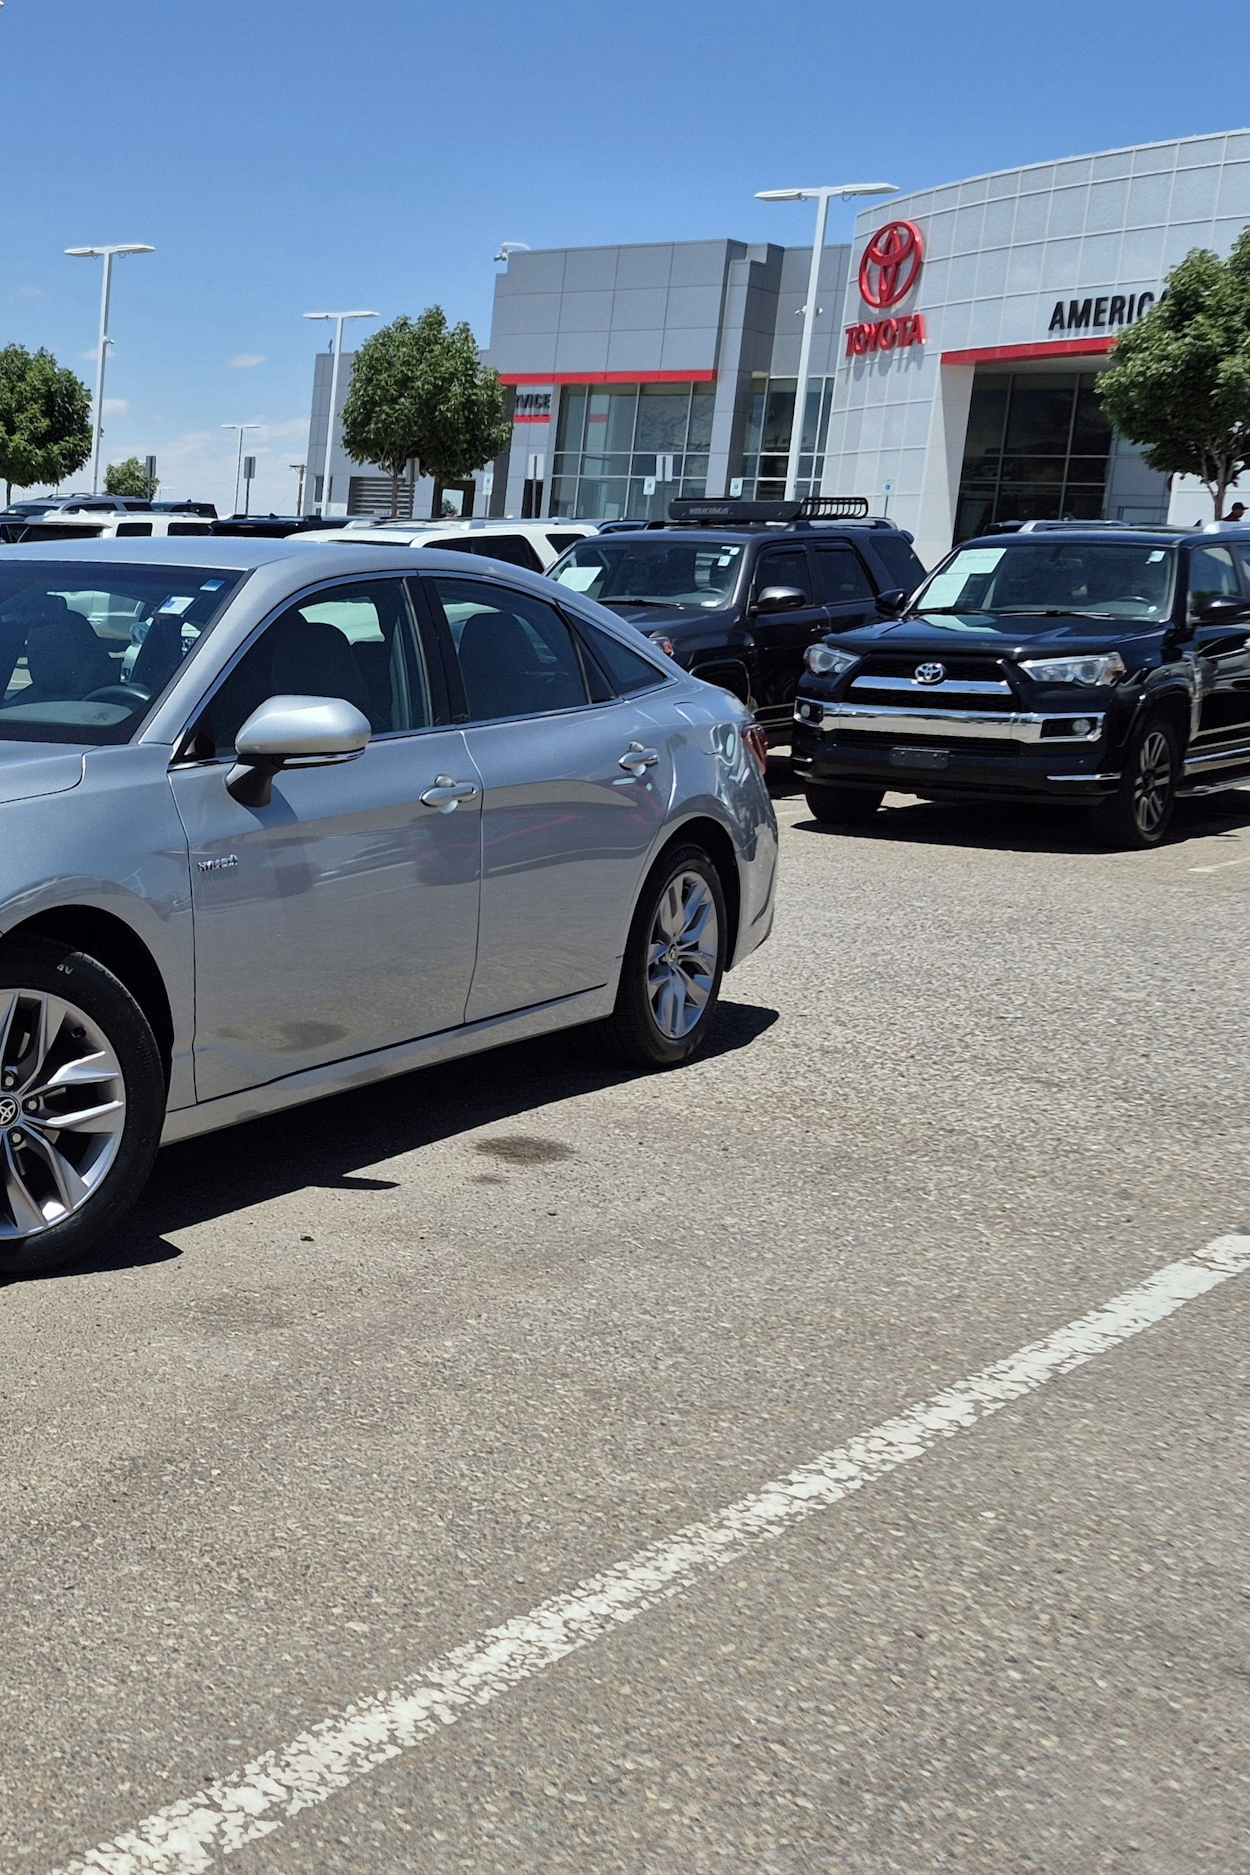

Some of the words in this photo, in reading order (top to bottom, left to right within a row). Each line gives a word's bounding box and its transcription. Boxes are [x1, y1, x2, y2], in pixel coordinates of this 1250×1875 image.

[1048, 288, 1169, 331] AMERIC
[845, 314, 924, 357] TOYOTA
[689, 507, 729, 515] YAKIMA
